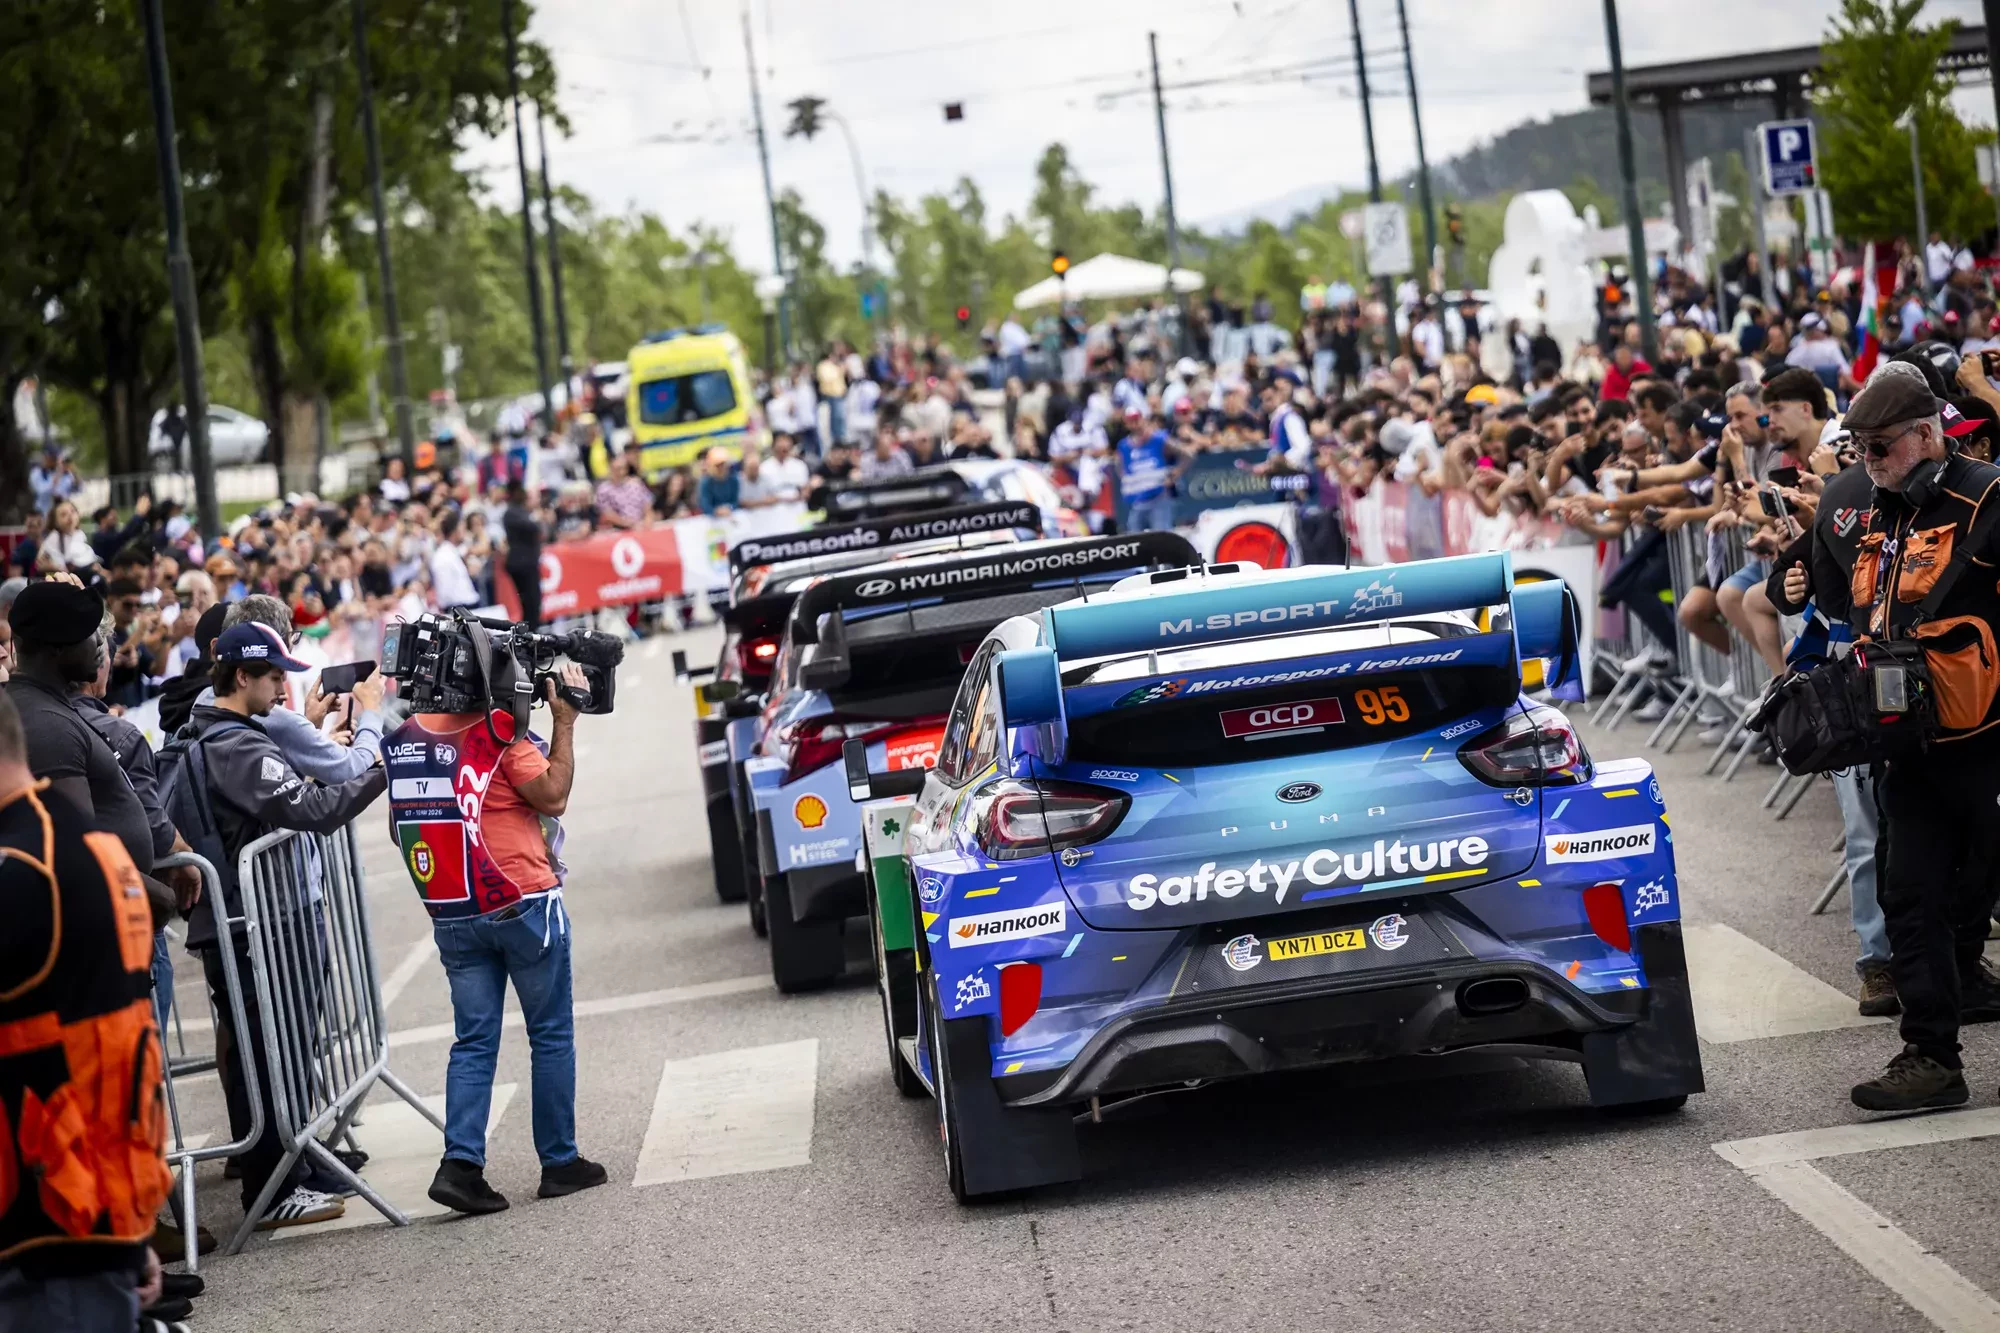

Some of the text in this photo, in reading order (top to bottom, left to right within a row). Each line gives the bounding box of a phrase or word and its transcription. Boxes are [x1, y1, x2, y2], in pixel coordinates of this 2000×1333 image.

[1778, 129, 1802, 160] P
[740, 508, 1031, 562] Panasonic AUTOMOTIVE
[901, 542, 1141, 591] HYUNDAI MOTORSPORT
[1160, 600, 1339, 636] M-SPORT
[1186, 649, 1463, 694] Motorsport Ireland
[1249, 703, 1314, 727] acp
[1354, 686, 1410, 725] 95
[1439, 719, 1481, 739] sparco
[388, 743, 427, 756] WRC
[1090, 769, 1139, 780] sparco
[416, 781, 428, 794] TV
[1286, 785, 1314, 799] Ford
[457, 764, 489, 847] 452
[1221, 806, 1386, 837] PUMA
[1570, 833, 1650, 854] HANKOOK
[1127, 835, 1489, 911] SafetyCulture
[920, 879, 939, 900] Ford
[976, 911, 1060, 936] HANKOOK
[1276, 932, 1357, 956] YN71 DCZ
